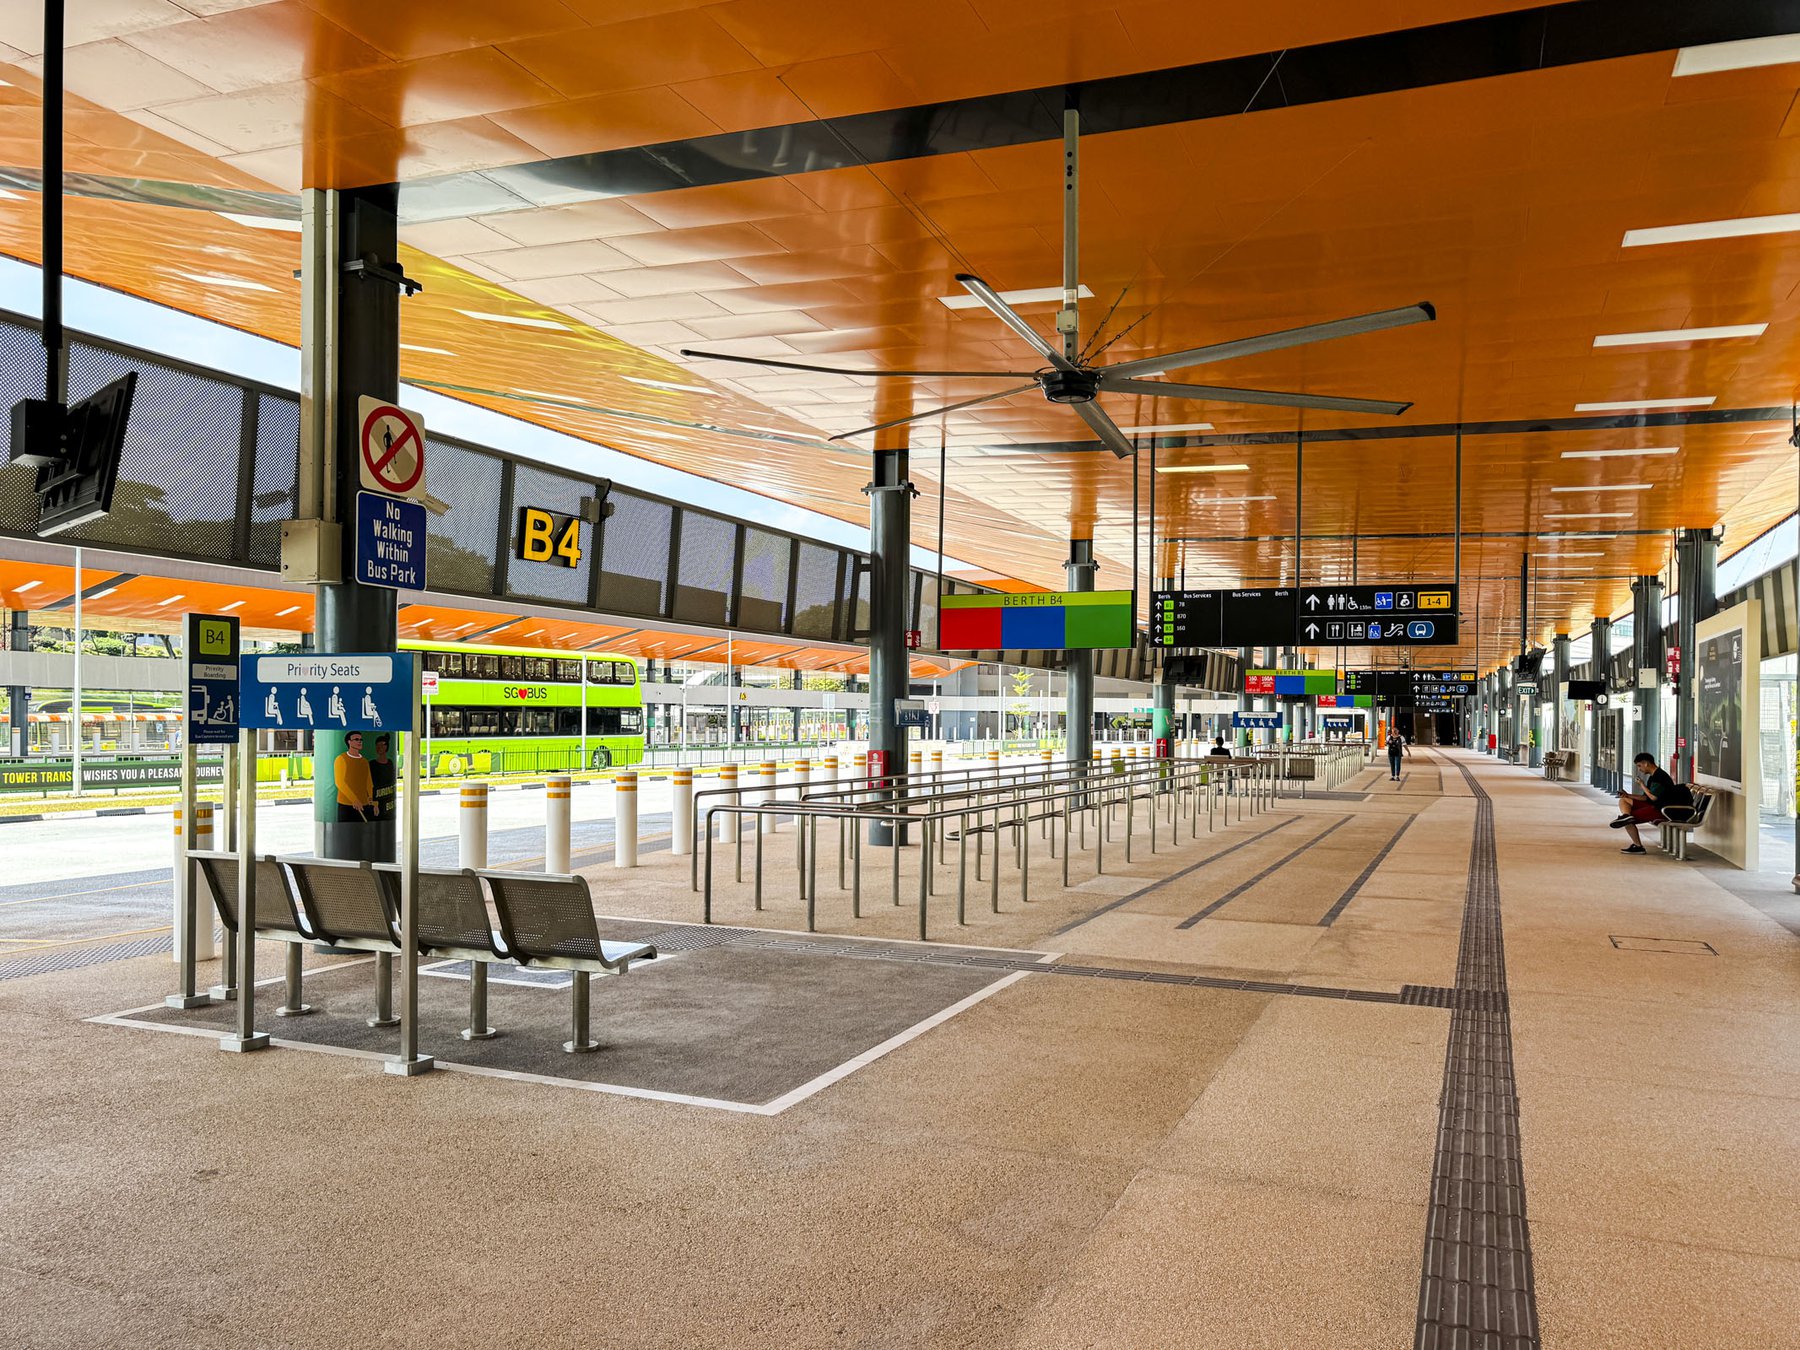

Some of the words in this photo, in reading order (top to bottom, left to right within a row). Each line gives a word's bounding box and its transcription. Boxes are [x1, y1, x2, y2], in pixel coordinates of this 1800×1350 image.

[386, 501, 400, 520] No
[373, 519, 412, 548] Walking
[520, 507, 582, 569] B4
[377, 540, 409, 562] Within
[367, 559, 387, 580] Bus
[390, 563, 416, 584] Park
[1004, 596, 1045, 606] BERTH
[1050, 595, 1063, 605] B4
[1426, 597, 1441, 606] 1-4
[206, 629, 225, 645] B4
[330, 662, 360, 677] Seats
[3, 772, 37, 784] TOWER
[40, 771, 72, 782] TRANS
[83, 769, 117, 781] WISHES
[120, 768, 138, 780] YOU
[139, 768, 146, 780] A
[148, 767, 183, 780] PLEASAN
[195, 767, 224, 778] OURNEY
